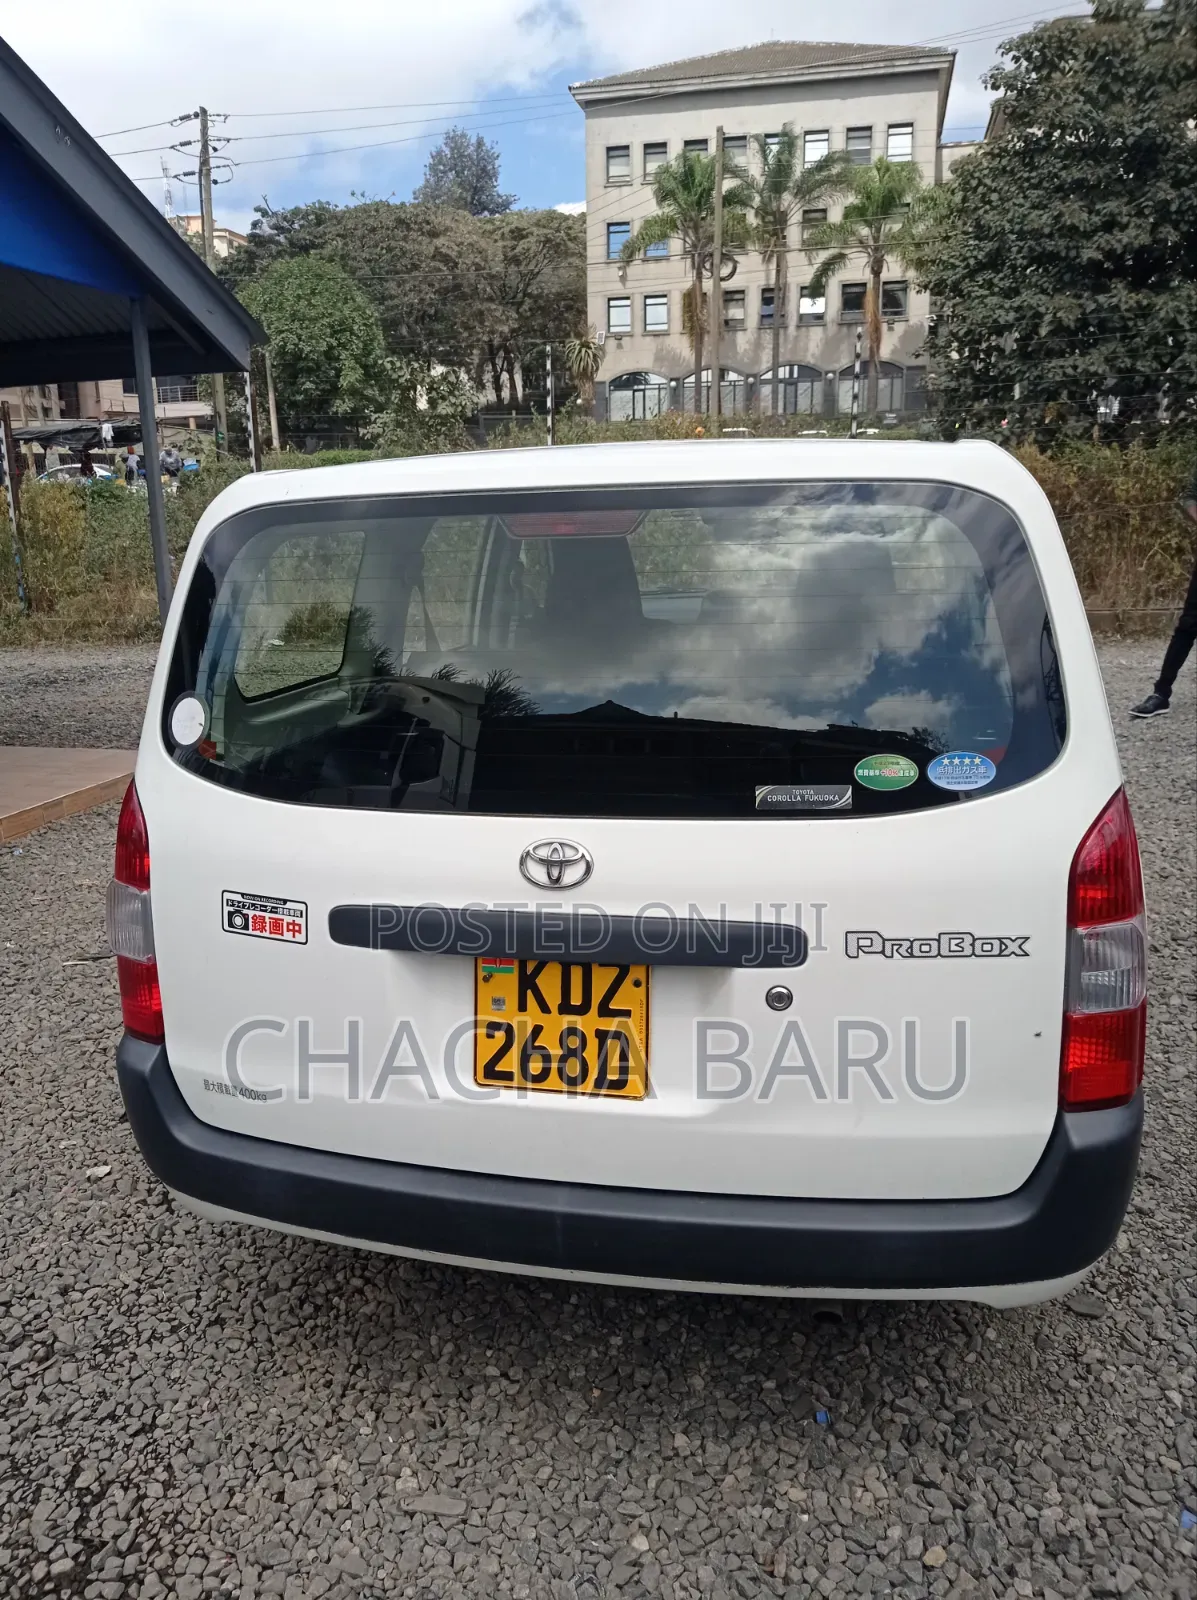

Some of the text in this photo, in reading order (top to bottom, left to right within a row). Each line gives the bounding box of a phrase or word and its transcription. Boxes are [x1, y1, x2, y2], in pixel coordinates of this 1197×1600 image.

[937, 765, 988, 775] 低排出ガス車
[767, 794, 840, 802] COROLLA FUKUOKA
[251, 913, 303, 939] 録画中
[518, 960, 632, 1018] KDZ
[483, 1021, 630, 1091] 268D
